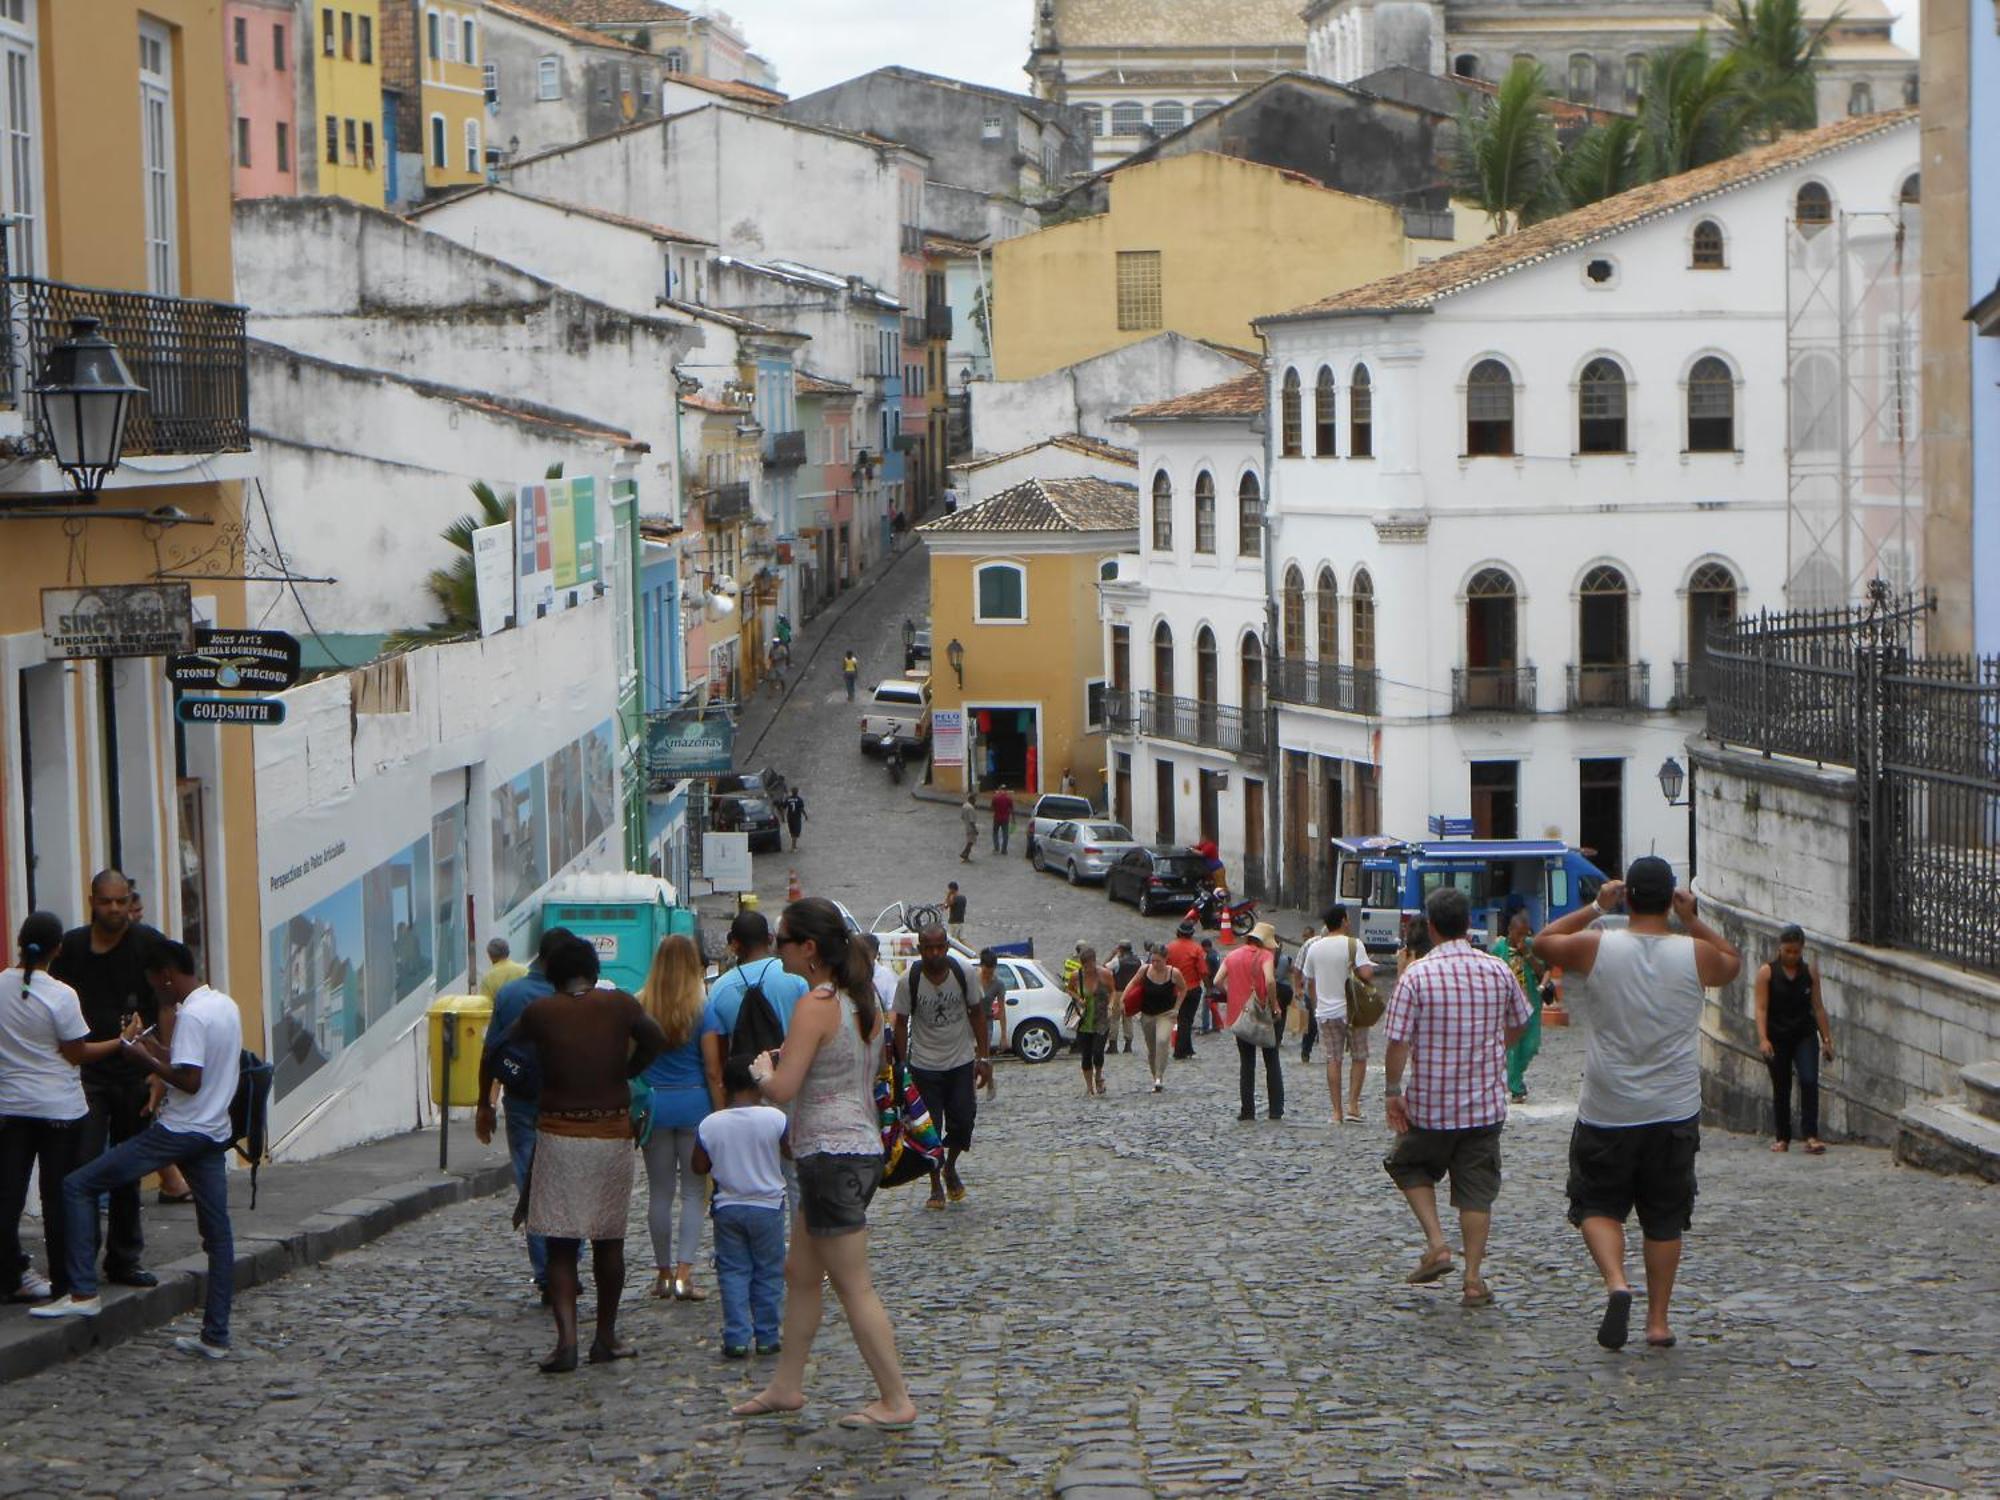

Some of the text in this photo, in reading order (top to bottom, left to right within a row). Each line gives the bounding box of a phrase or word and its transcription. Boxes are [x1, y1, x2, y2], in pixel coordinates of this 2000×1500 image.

[176, 668, 288, 682] STONES PRECIOUS
[193, 703, 269, 720] GOLDSMITH
